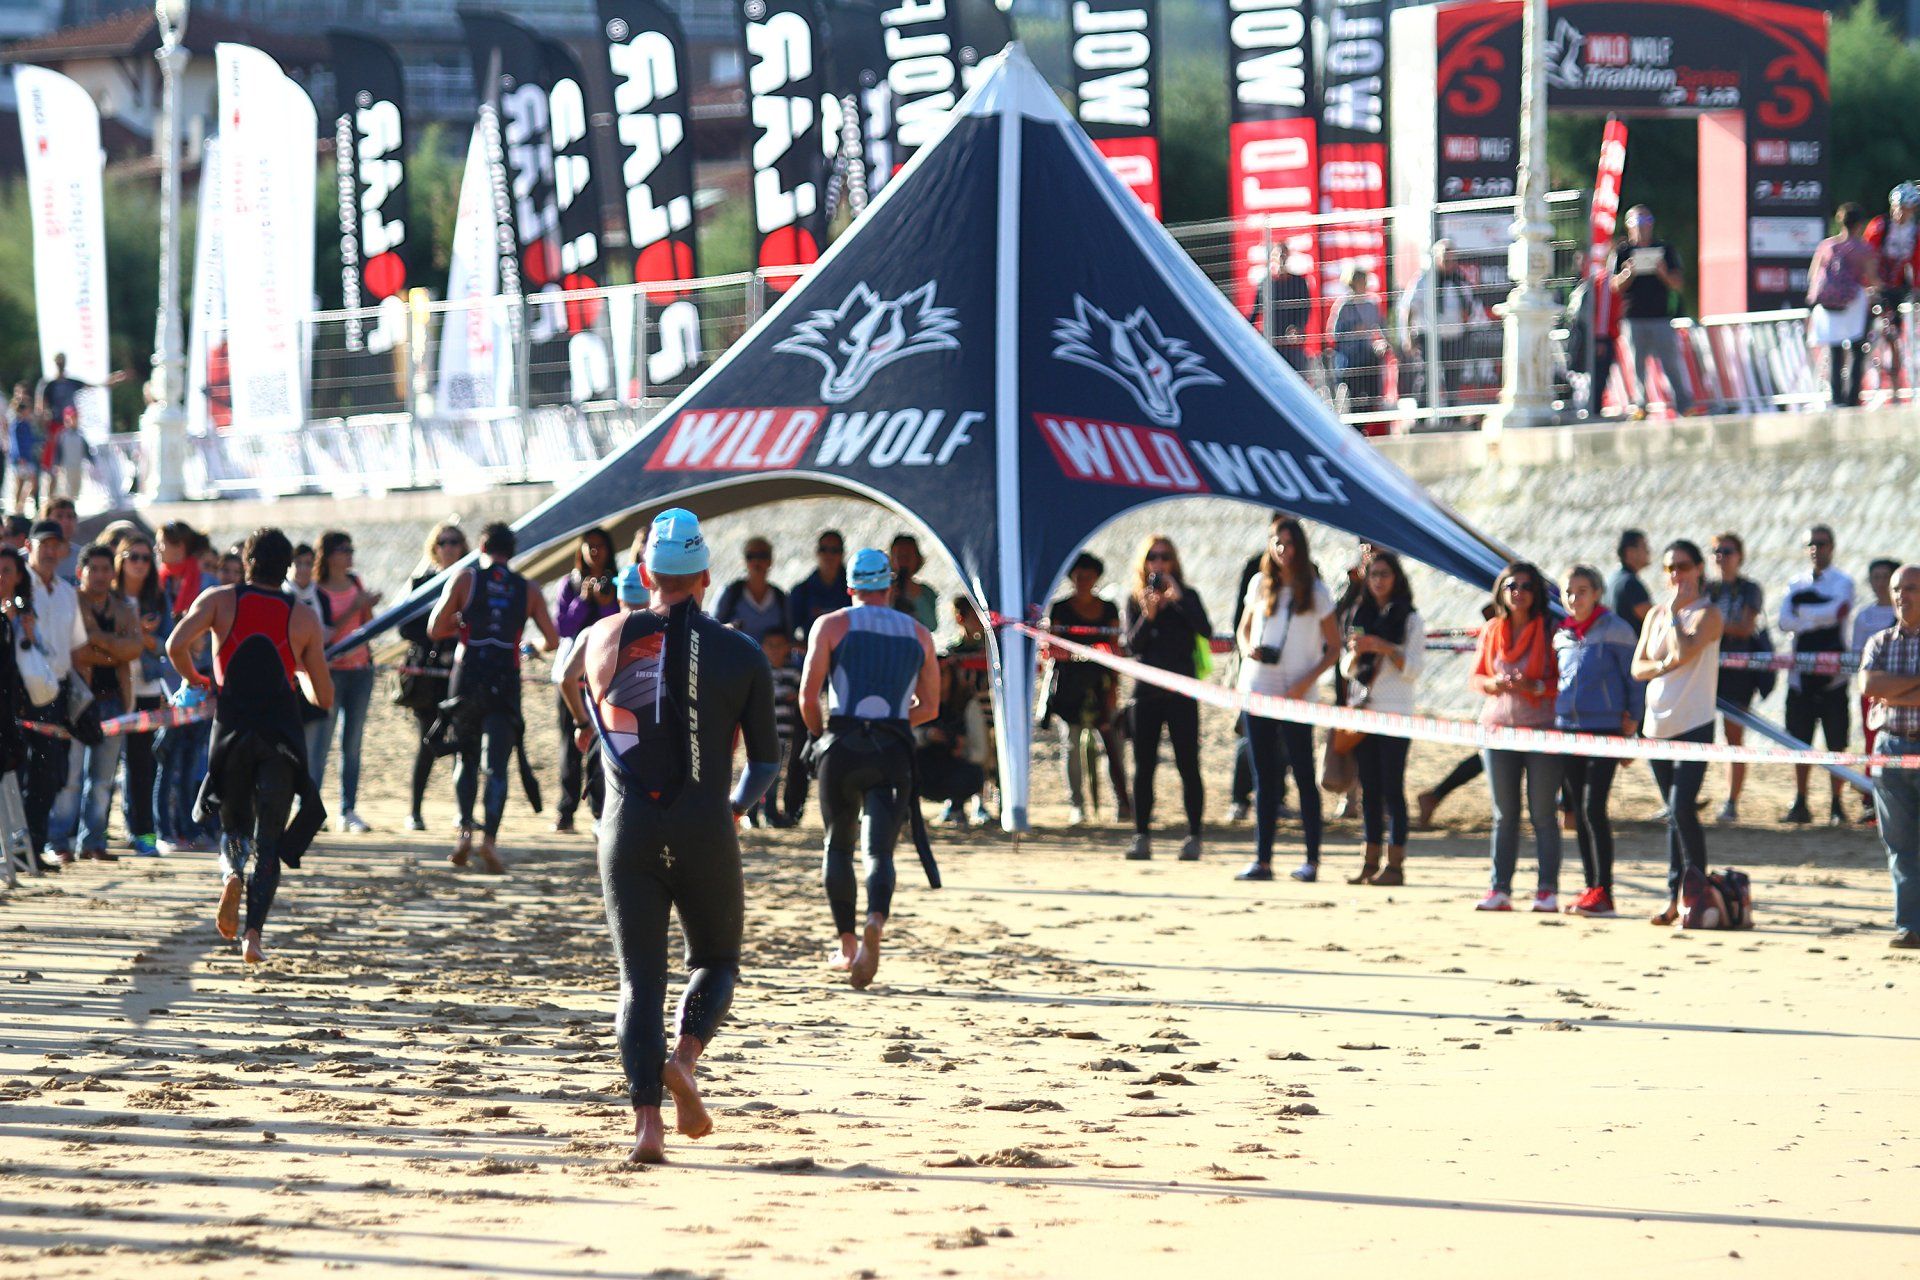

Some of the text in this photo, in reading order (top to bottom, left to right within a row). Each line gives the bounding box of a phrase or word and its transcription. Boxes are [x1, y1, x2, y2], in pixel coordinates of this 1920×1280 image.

[664, 407, 986, 468] WILD WOLF
[1044, 418, 1351, 505] WILD WOLF
[688, 628, 701, 783] PROFILE DESIGN
